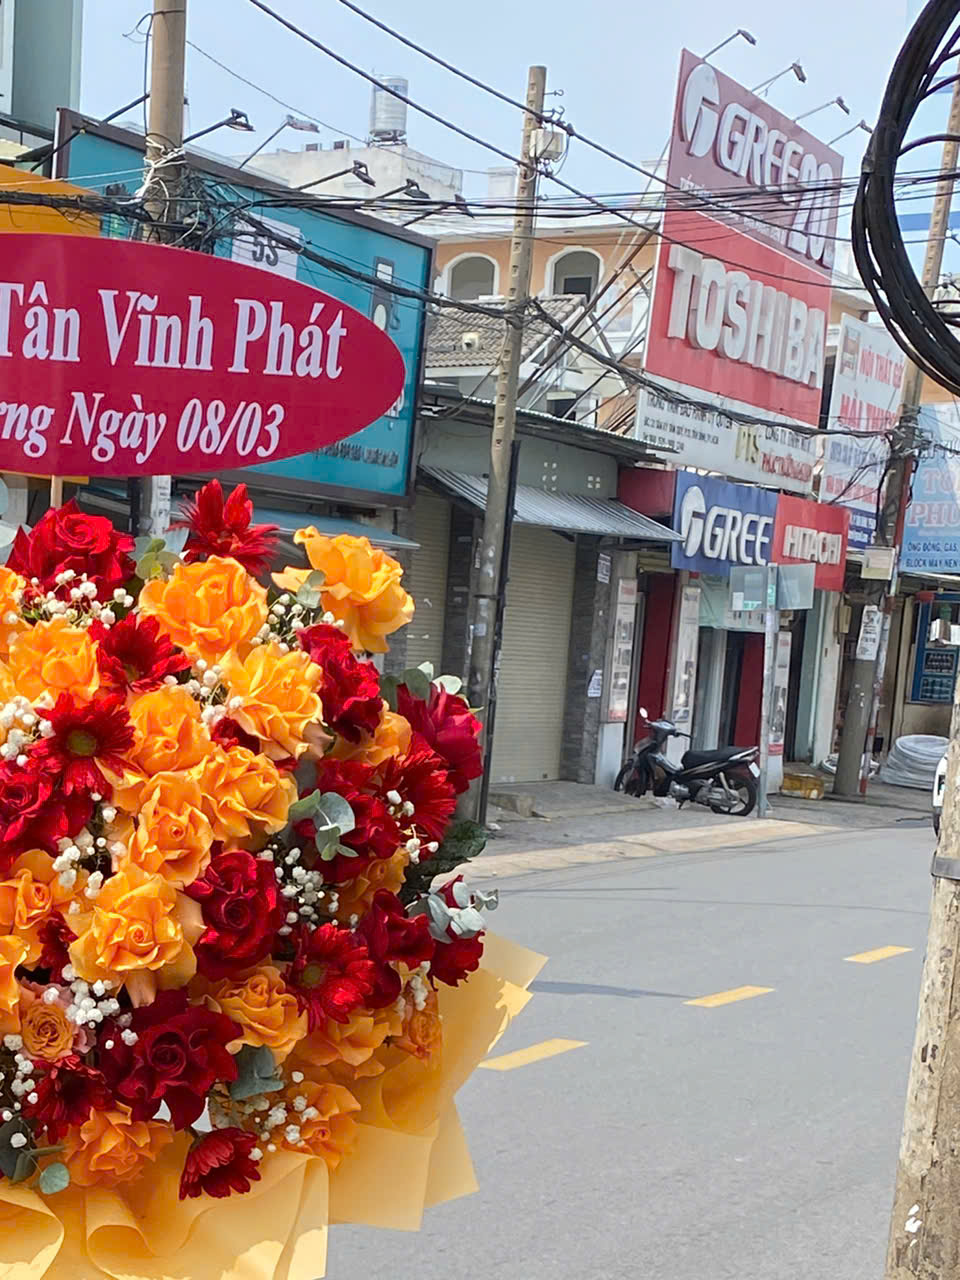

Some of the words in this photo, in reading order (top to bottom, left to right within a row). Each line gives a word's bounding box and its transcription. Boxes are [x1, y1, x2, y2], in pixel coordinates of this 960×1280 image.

[717, 102, 803, 206] GREE
[98, 289, 215, 371] Vĩnh
[227, 298, 347, 380] Phát
[667, 244, 826, 390] TOSHIBA
[59, 391, 168, 465] Ngày
[176, 397, 286, 459] 08/03
[704, 506, 774, 567] GREE
